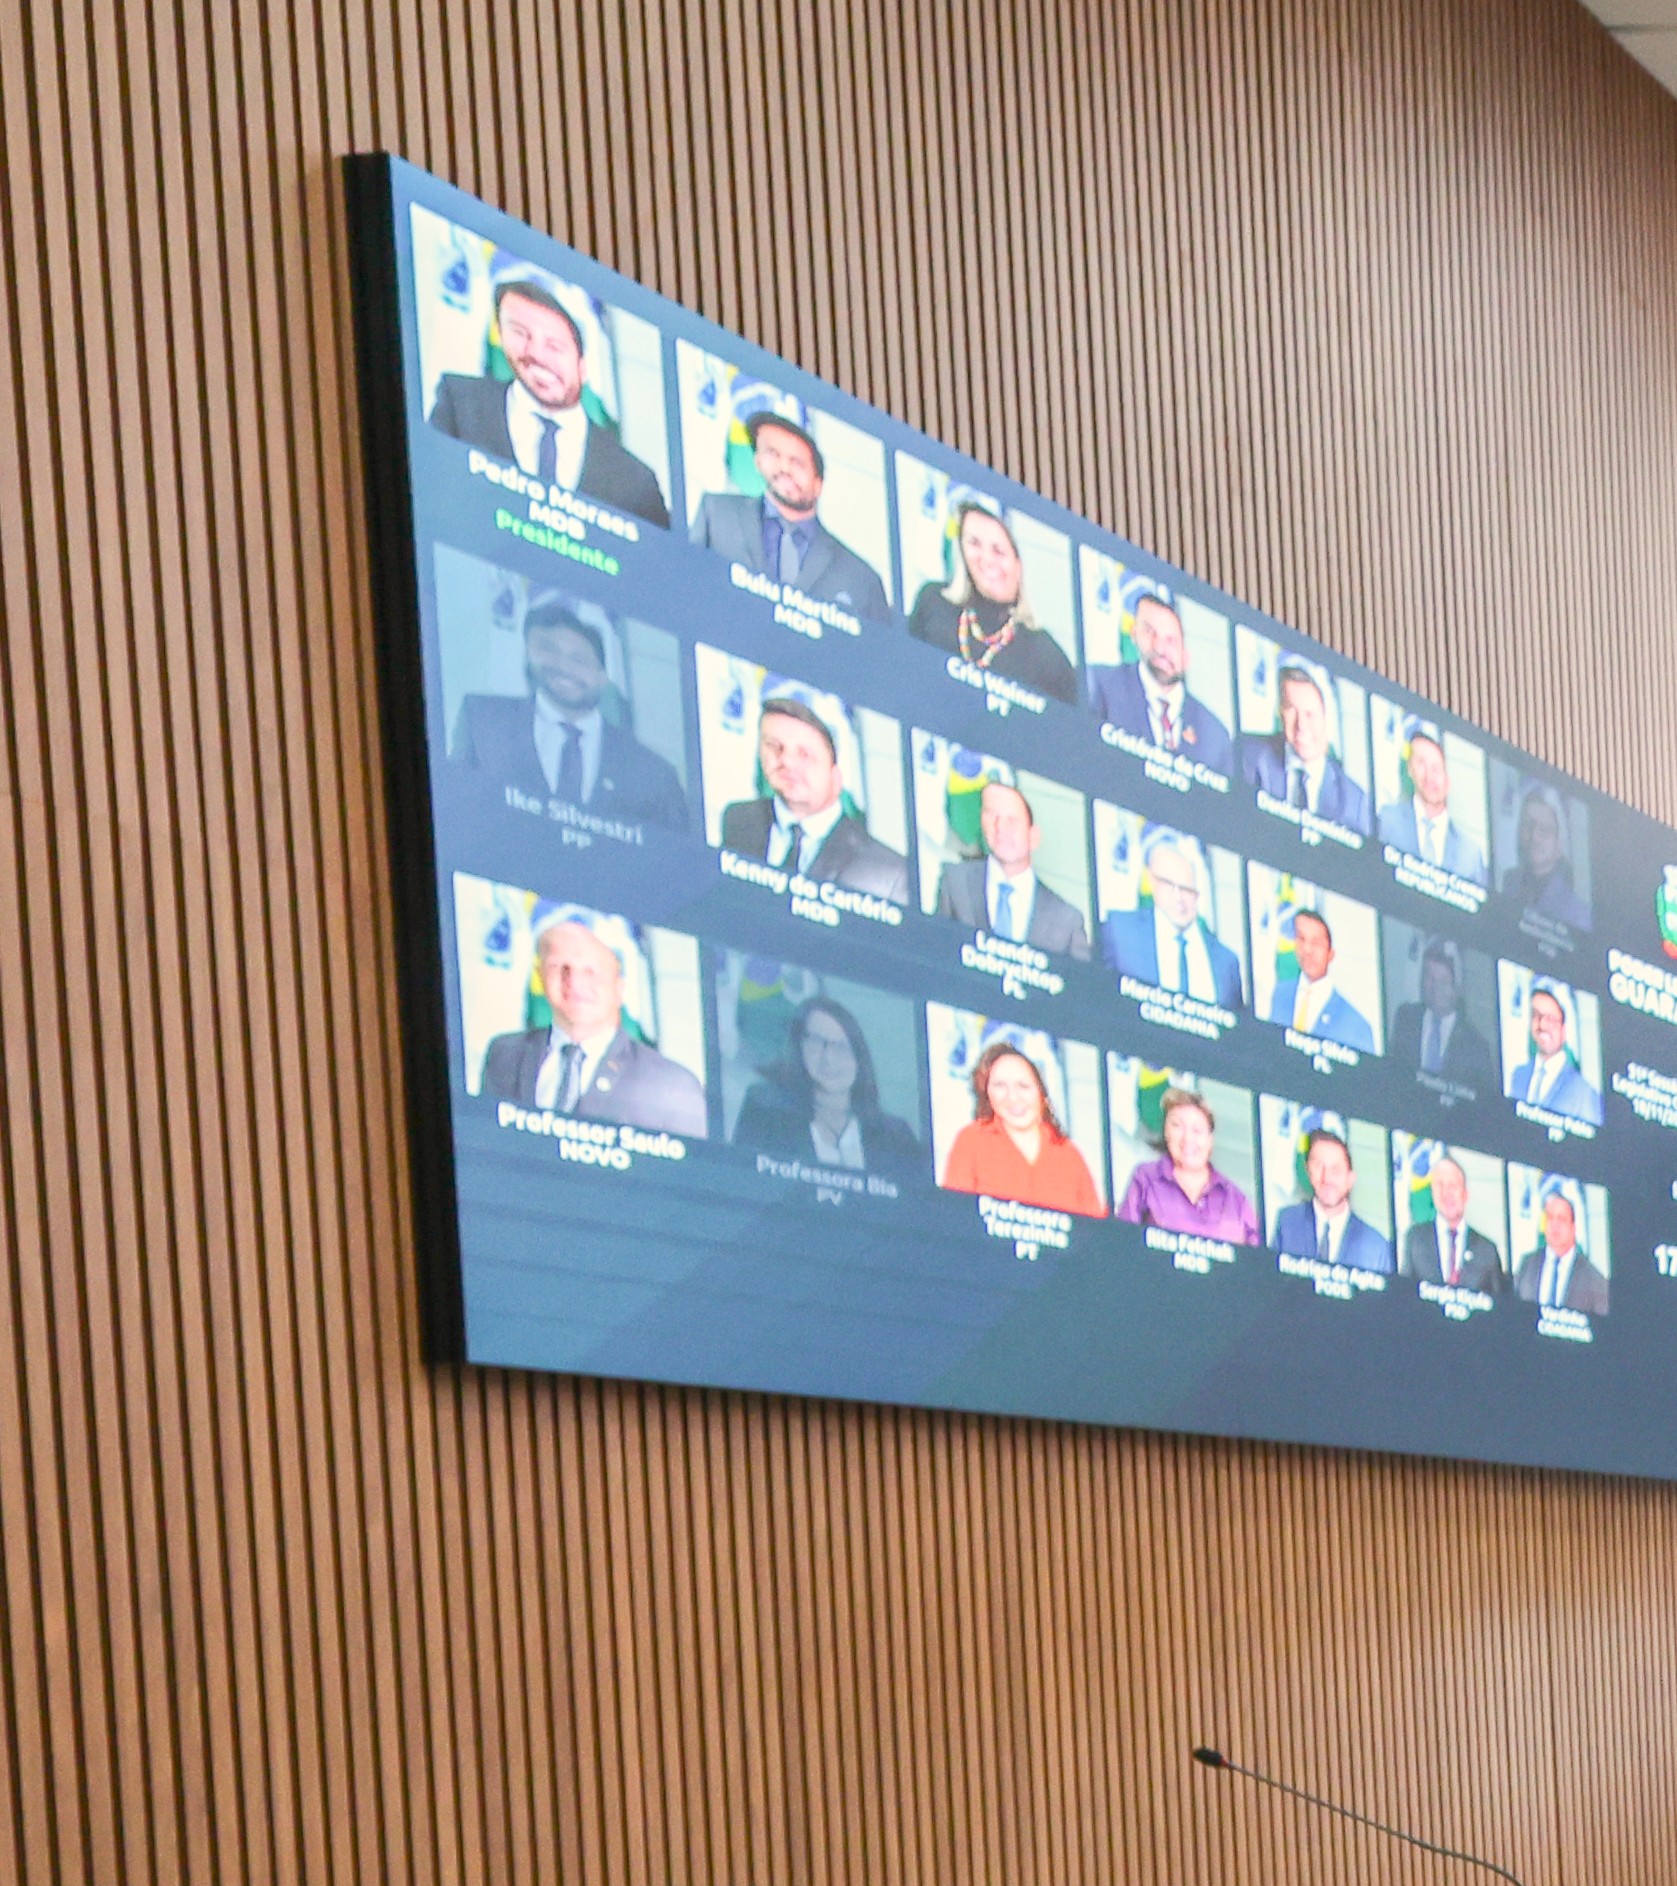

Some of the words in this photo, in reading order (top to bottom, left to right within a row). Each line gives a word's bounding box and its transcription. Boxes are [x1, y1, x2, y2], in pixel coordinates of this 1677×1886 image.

[468, 449, 545, 501] Pedro
[549, 485, 639, 542] Moraes
[529, 501, 586, 540] MDB
[496, 508, 620, 576] Presidente
[731, 562, 780, 600] Bulu
[783, 584, 861, 636] Martins
[774, 604, 822, 639] MDB
[946, 657, 983, 688] Cris
[1144, 760, 1191, 792] NOVO
[505, 787, 542, 815] Ike
[547, 798, 643, 846] Silvestri
[562, 827, 592, 849] PP
[720, 850, 787, 894] Kenny
[788, 873, 818, 899] do
[819, 881, 902, 926] Cartório
[791, 897, 840, 927] MDB
[976, 929, 1048, 970] Leandro
[1608, 948, 1665, 989] PODER
[1139, 1001, 1221, 1040] CIDADANIA
[1172, 992, 1237, 1029] Carneiro
[1285, 1027, 1321, 1056] Nego
[497, 1101, 617, 1146] Professor
[619, 1127, 686, 1160] Saulo
[560, 1139, 631, 1170] NOVO
[757, 1154, 864, 1192] Professora
[868, 1175, 898, 1198] Bia
[818, 1188, 842, 1206] PV
[979, 1195, 1071, 1232] Professora
[984, 1215, 1069, 1248] Terezinha
[1145, 1226, 1177, 1251] Rita
[1015, 1240, 1039, 1261] PT
[1173, 1252, 1210, 1274] MDB
[1279, 1253, 1331, 1279] Rodrigo
